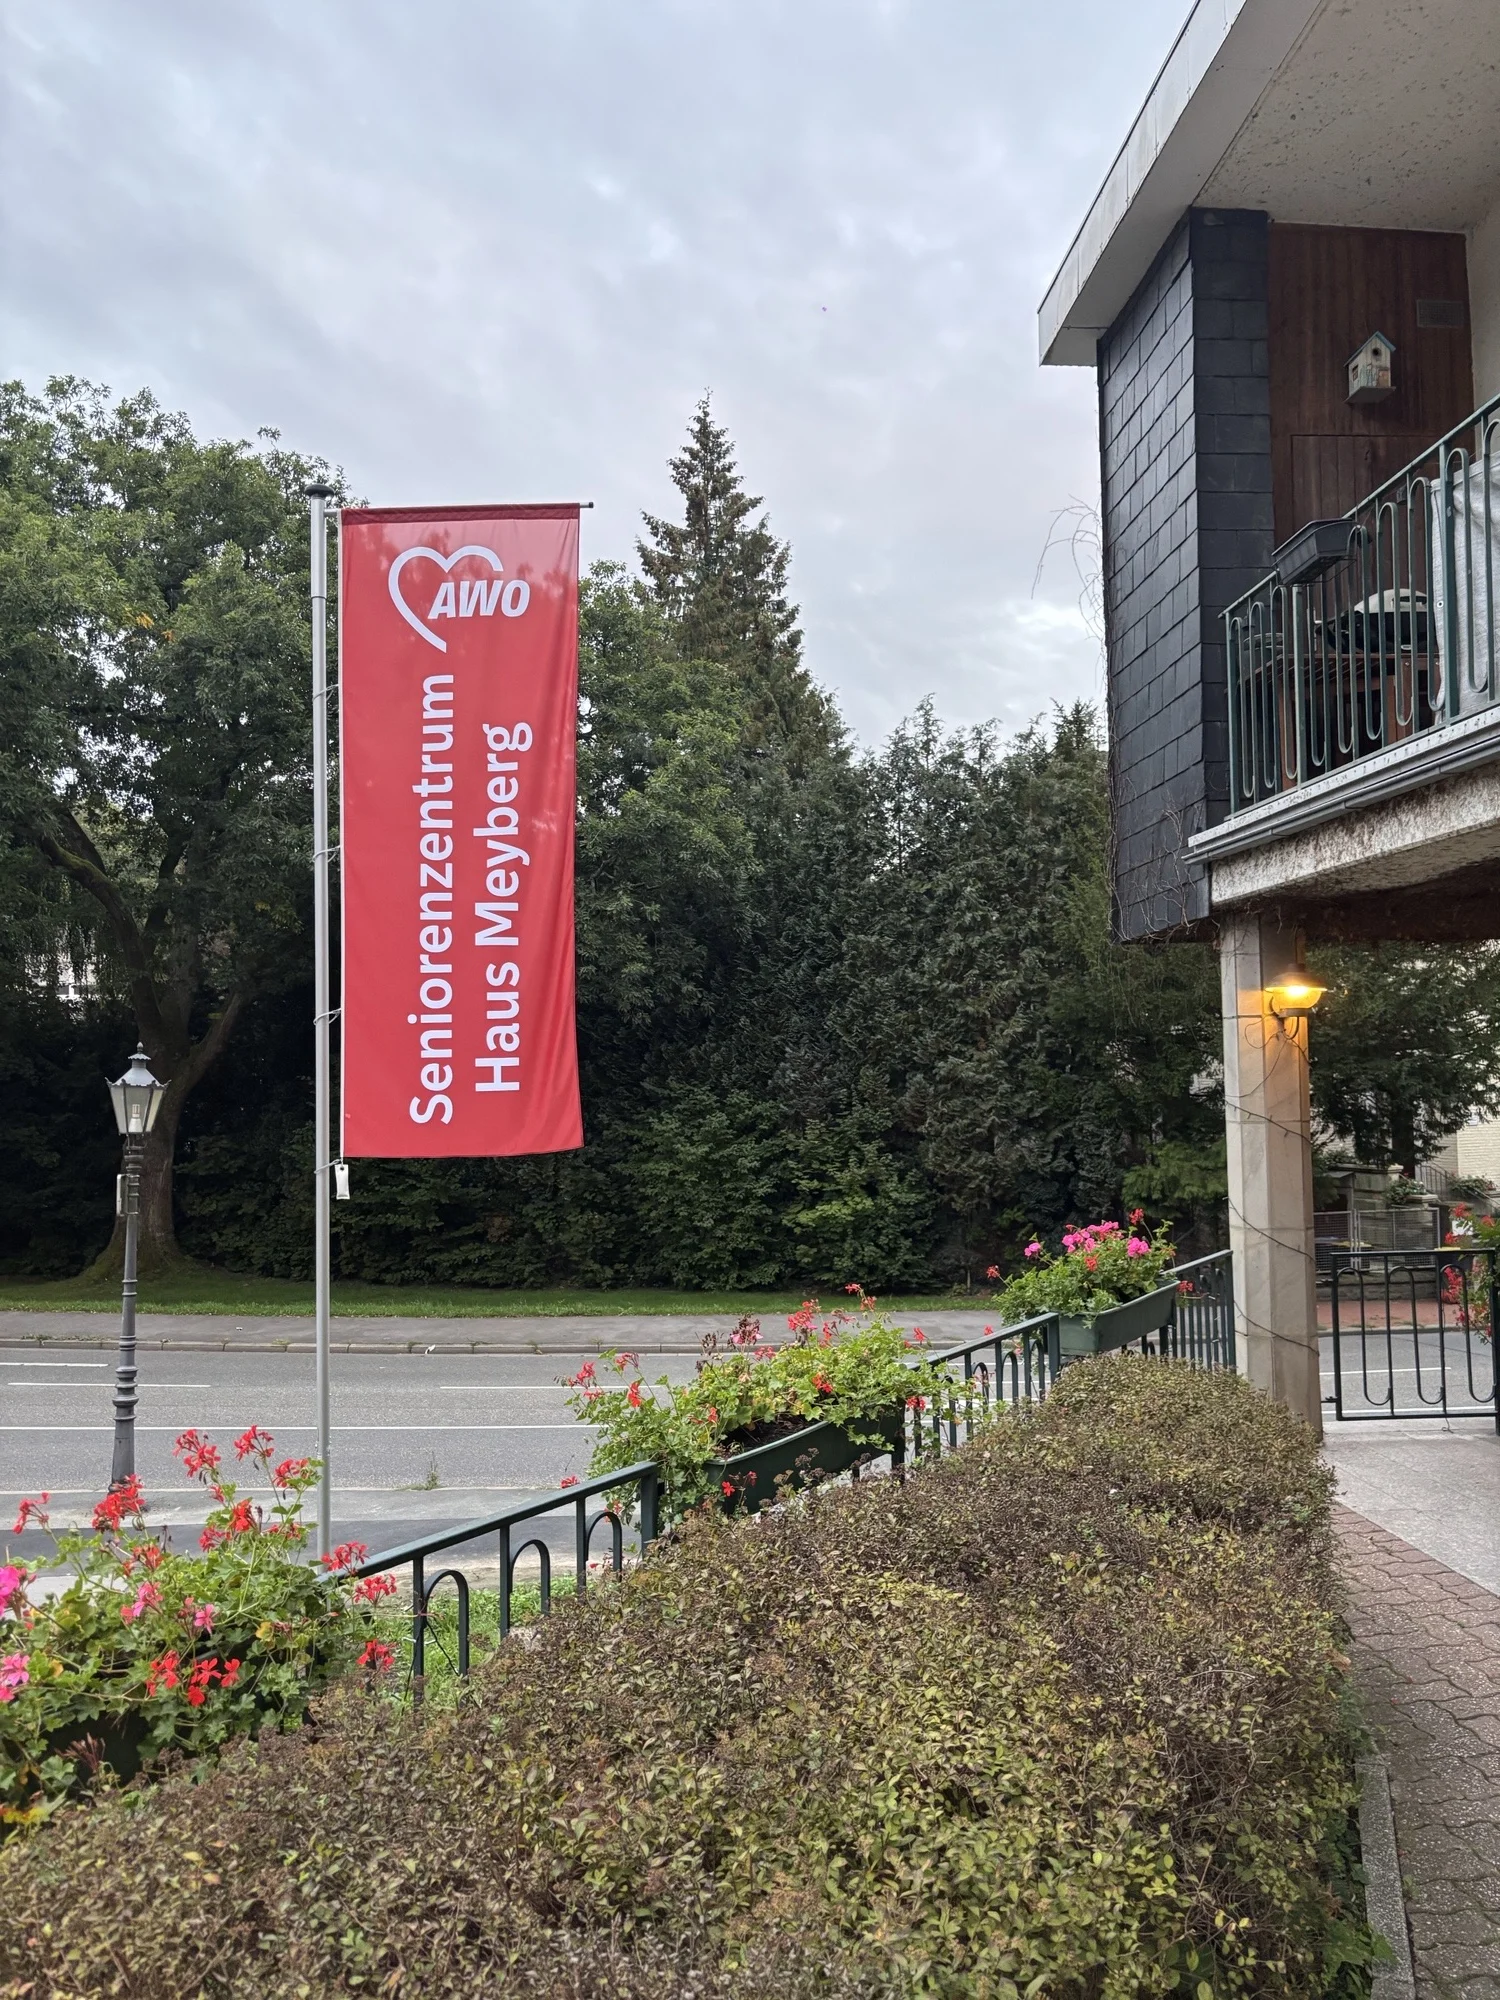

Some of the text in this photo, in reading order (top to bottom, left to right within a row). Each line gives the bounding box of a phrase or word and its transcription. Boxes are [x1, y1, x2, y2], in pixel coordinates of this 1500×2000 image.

[427, 579, 531, 619] AWO
[408, 674, 454, 1126] Seniorenzentrum
[473, 721, 533, 1092] Haus Meyberg
